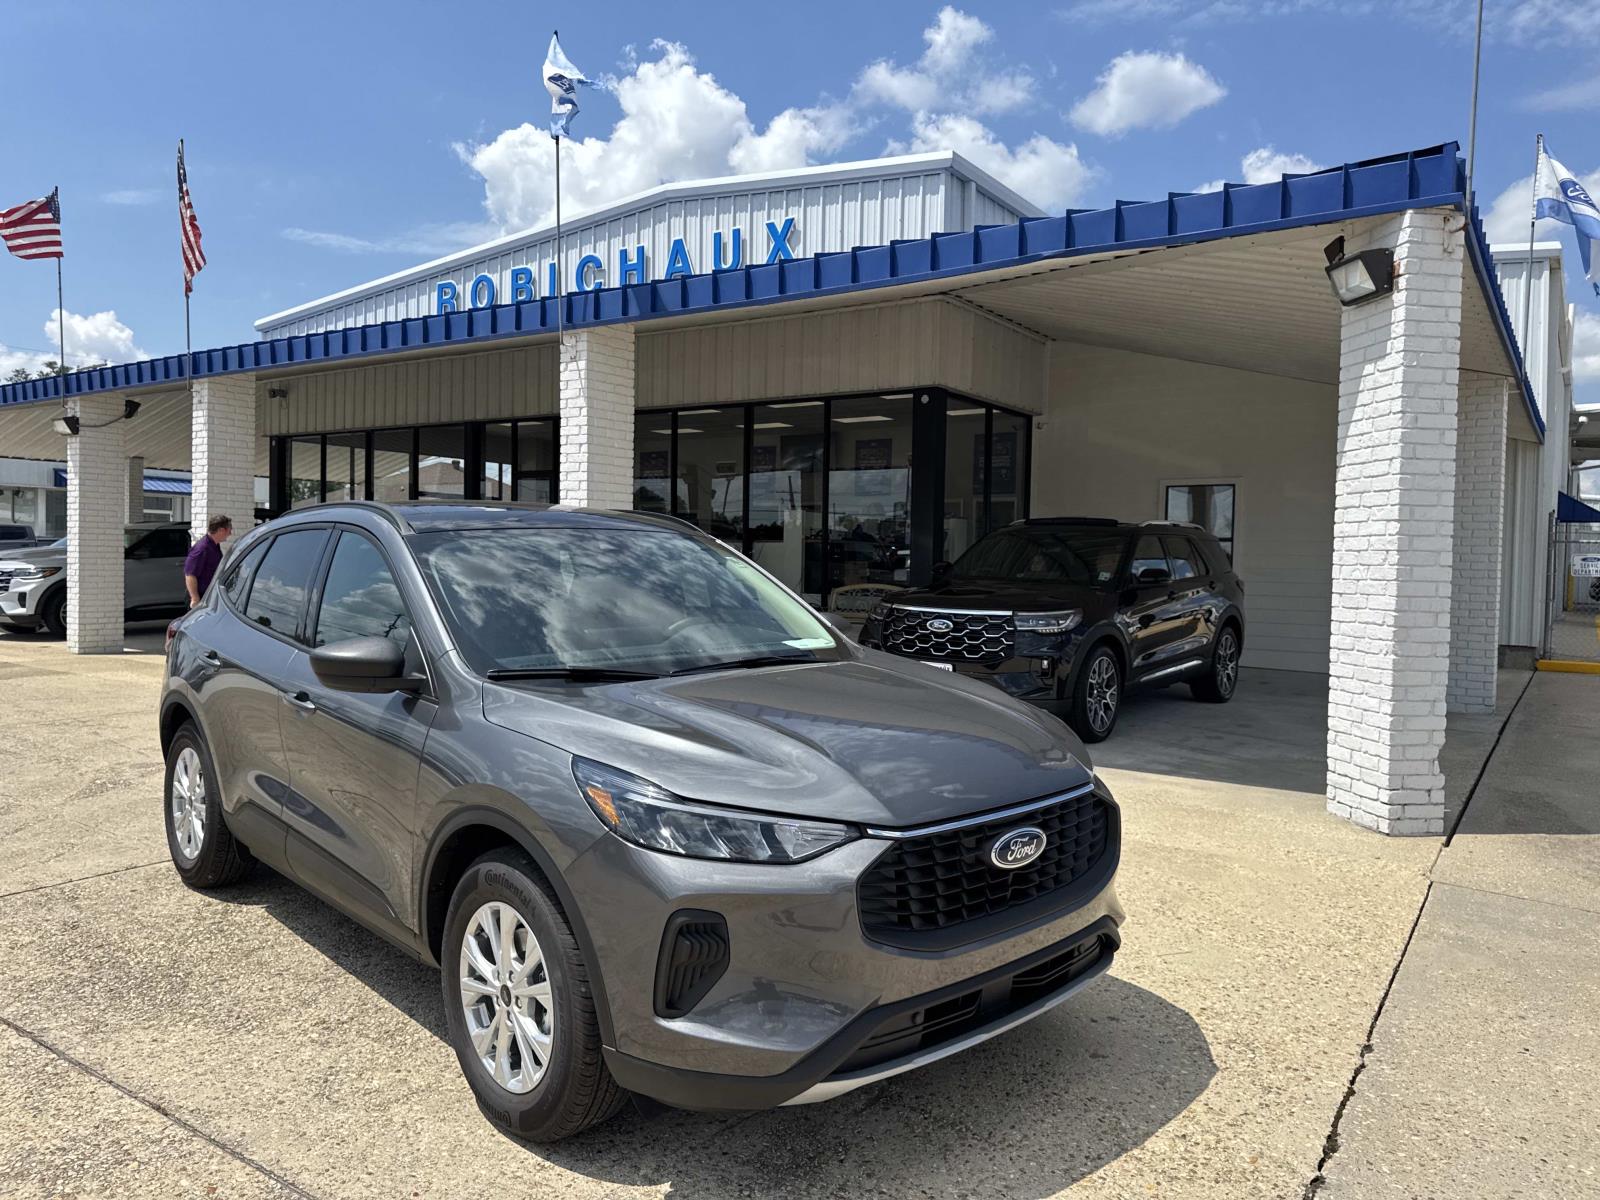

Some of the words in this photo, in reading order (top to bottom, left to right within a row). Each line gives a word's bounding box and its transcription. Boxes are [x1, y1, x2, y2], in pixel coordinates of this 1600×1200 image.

[436, 216, 796, 314] ROBICHAUX
[1007, 836, 1037, 861] Ford
[484, 869, 533, 909] Continental
